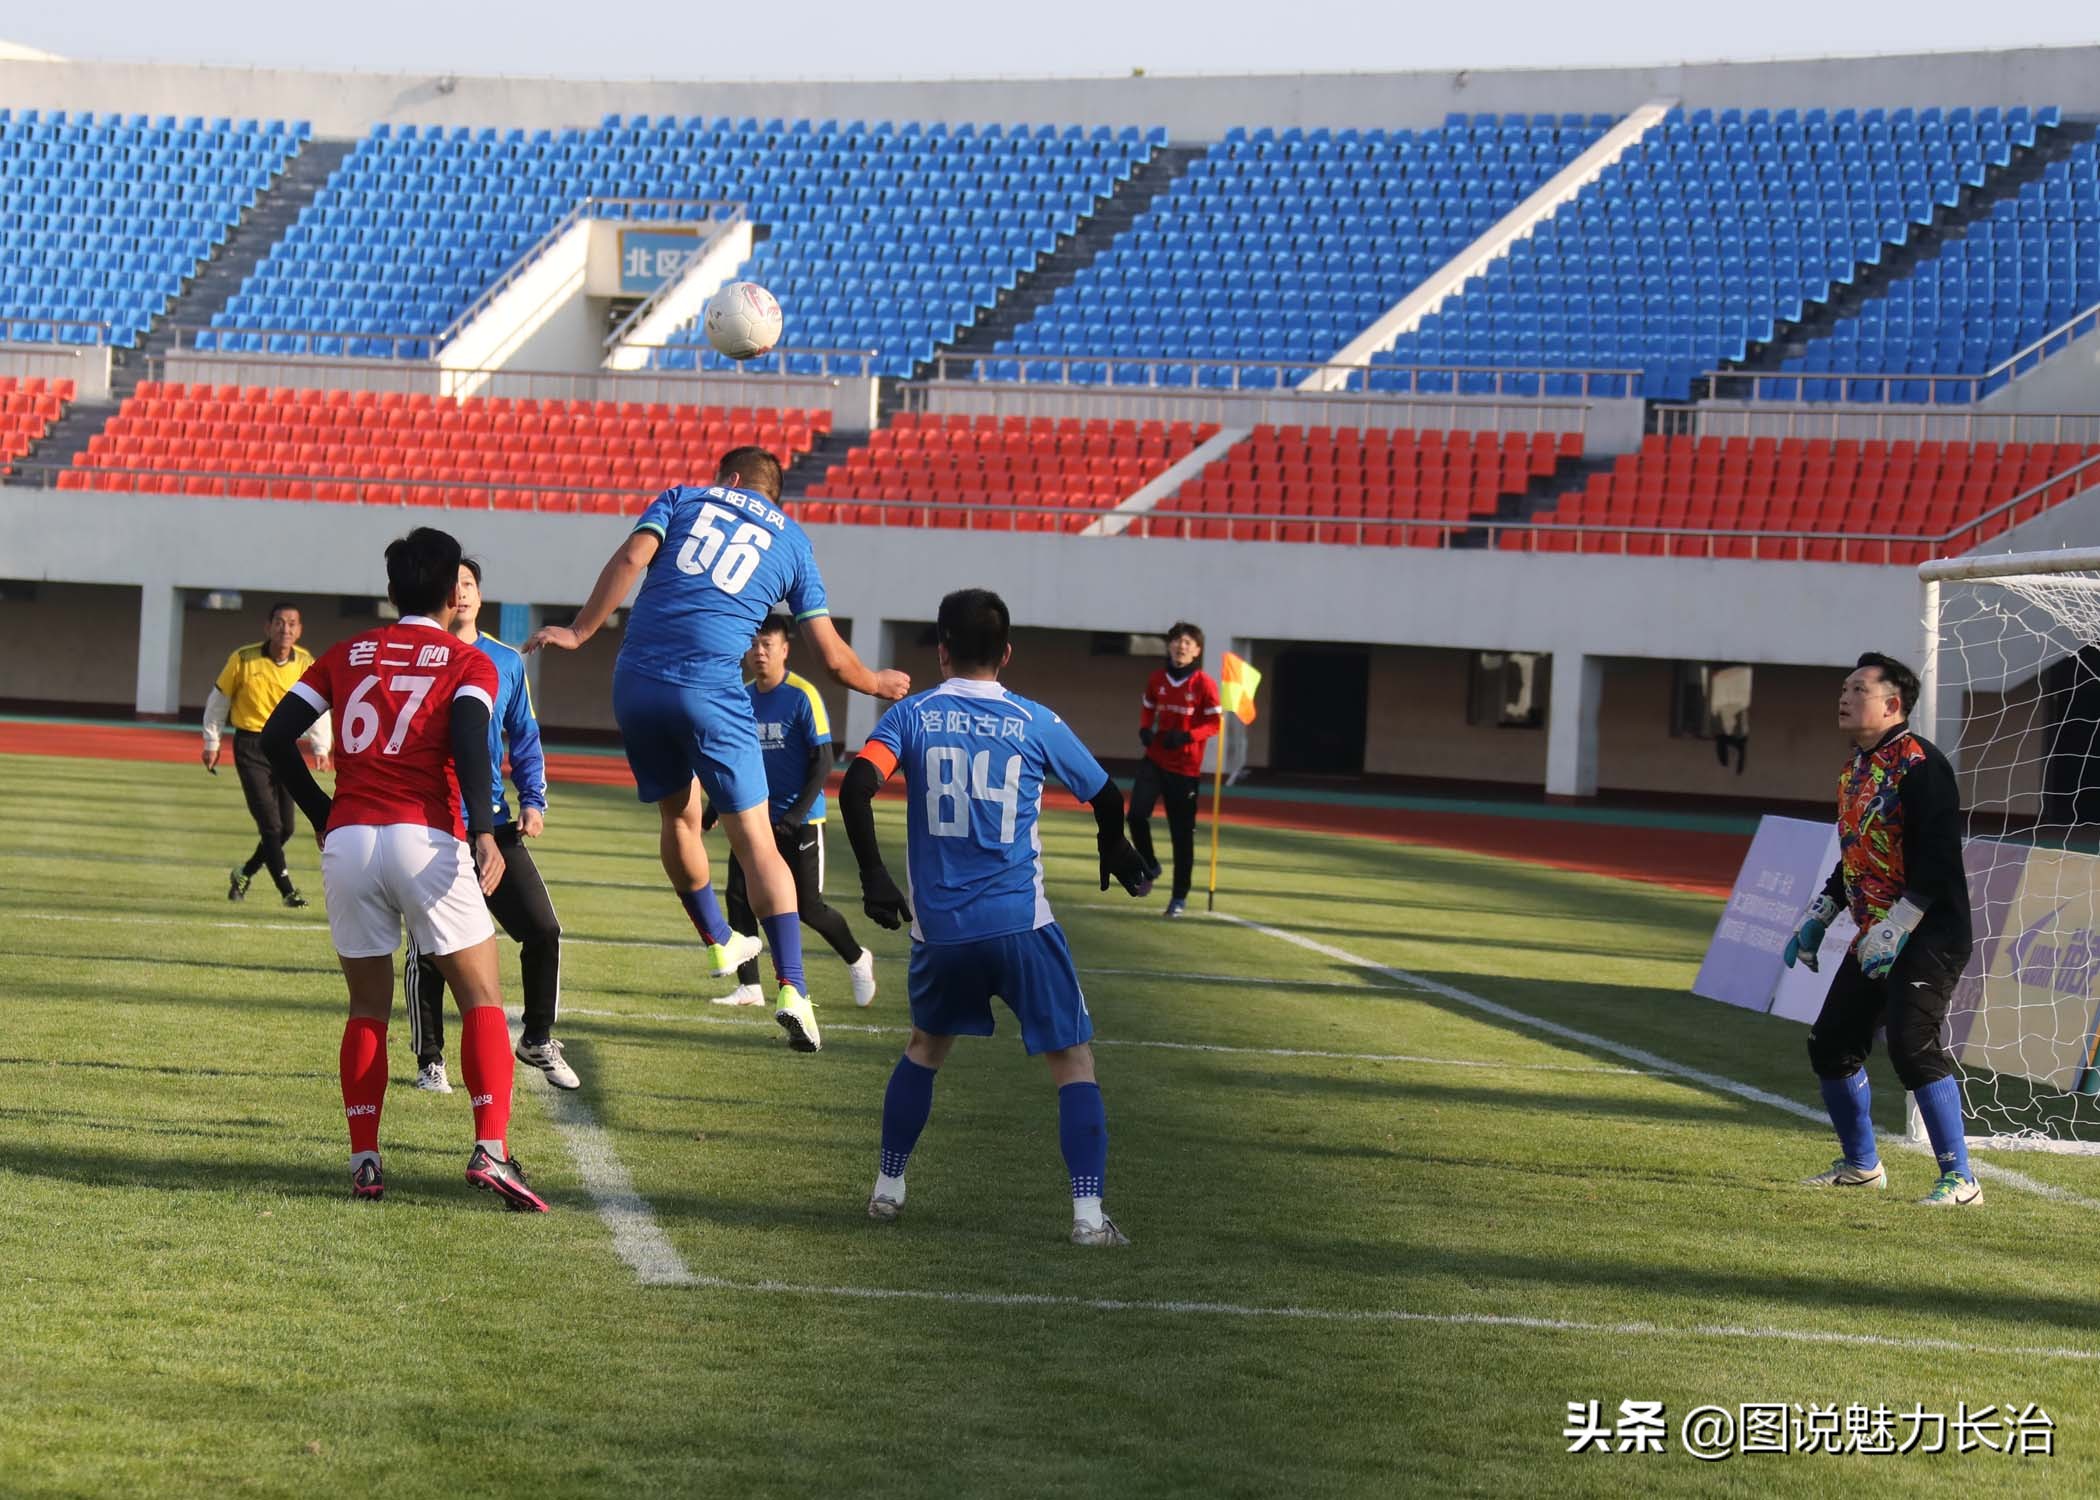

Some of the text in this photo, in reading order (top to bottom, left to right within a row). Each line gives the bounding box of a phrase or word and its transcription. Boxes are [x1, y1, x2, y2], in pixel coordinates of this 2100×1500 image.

[624, 247, 698, 278] 北区
[676, 501, 772, 595] 56
[341, 674, 436, 755] 67
[920, 710, 1026, 743] 洛阳古风
[925, 746, 1023, 844] 84
